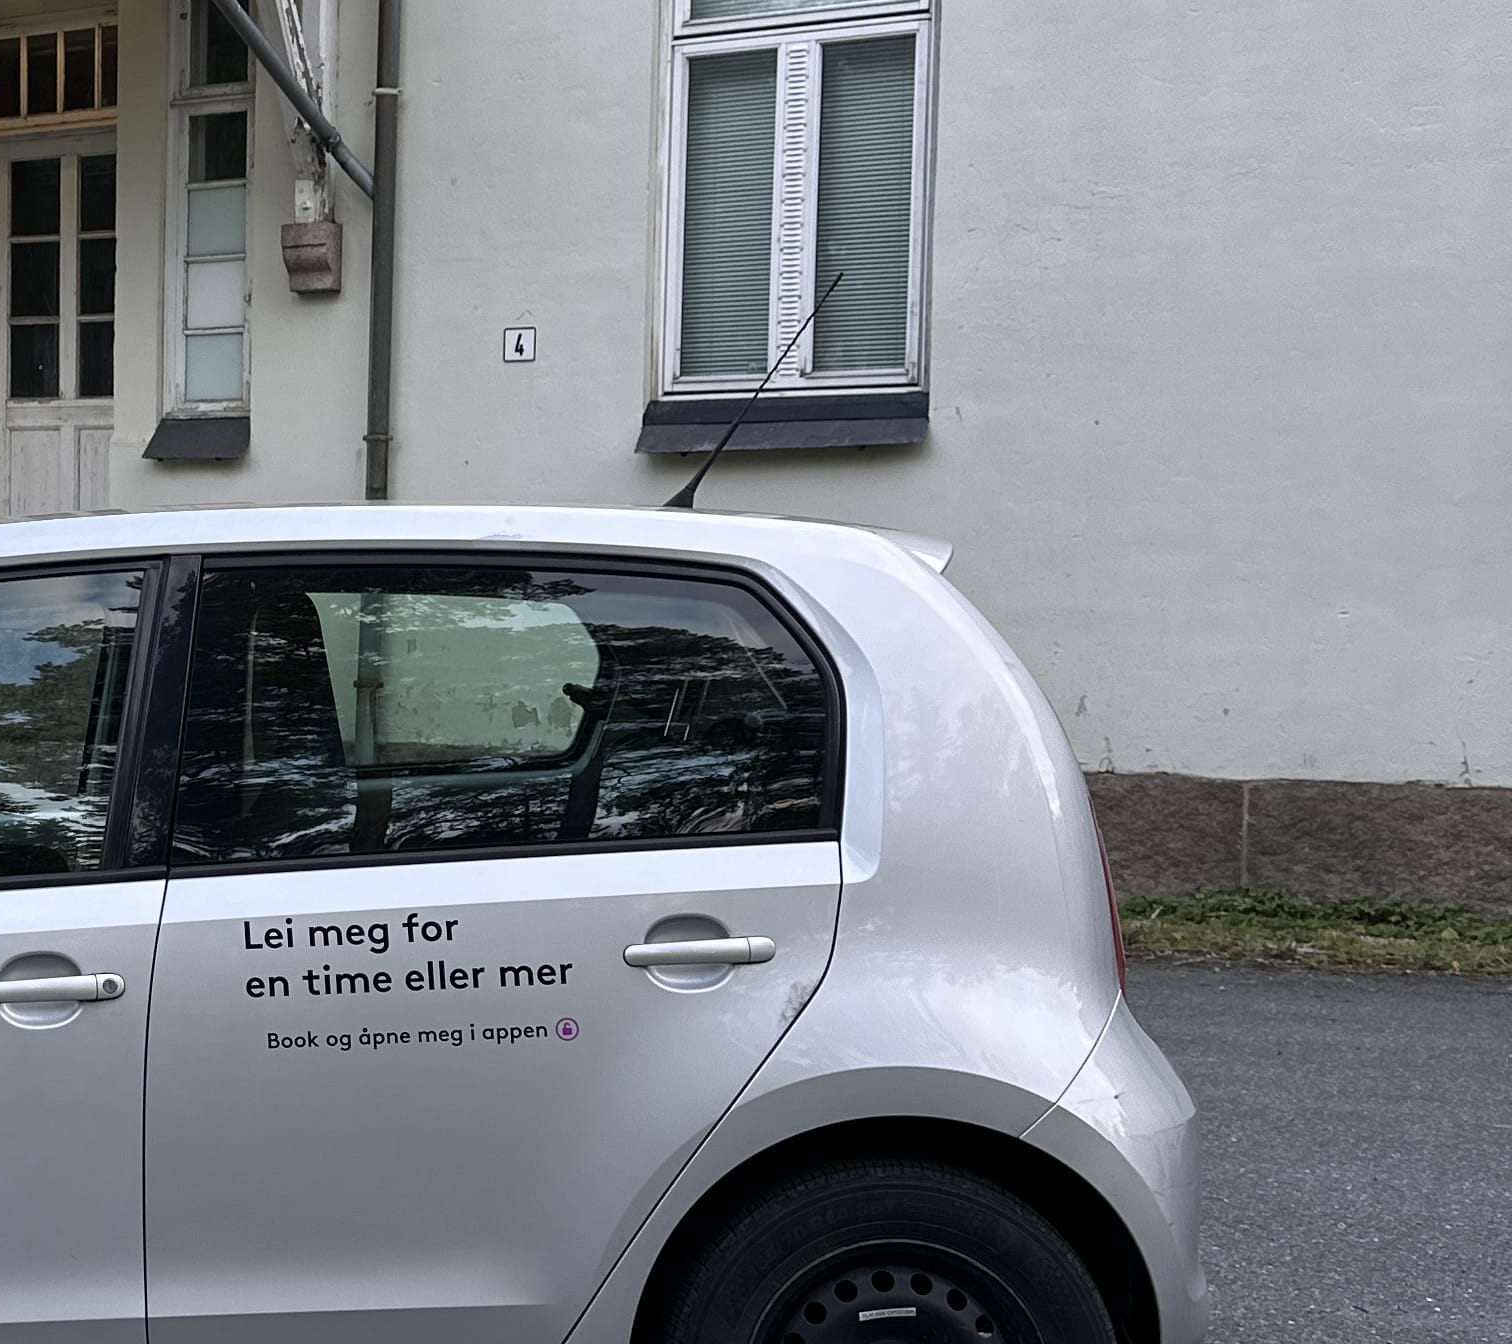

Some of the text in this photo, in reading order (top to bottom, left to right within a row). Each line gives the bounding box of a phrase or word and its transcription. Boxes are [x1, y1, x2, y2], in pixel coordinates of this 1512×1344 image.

[514, 332, 525, 357] 4
[243, 912, 459, 954] Lei meg for
[245, 960, 573, 998] en time eller mer
[267, 1023, 548, 1052] Book og åpne meg i appen
